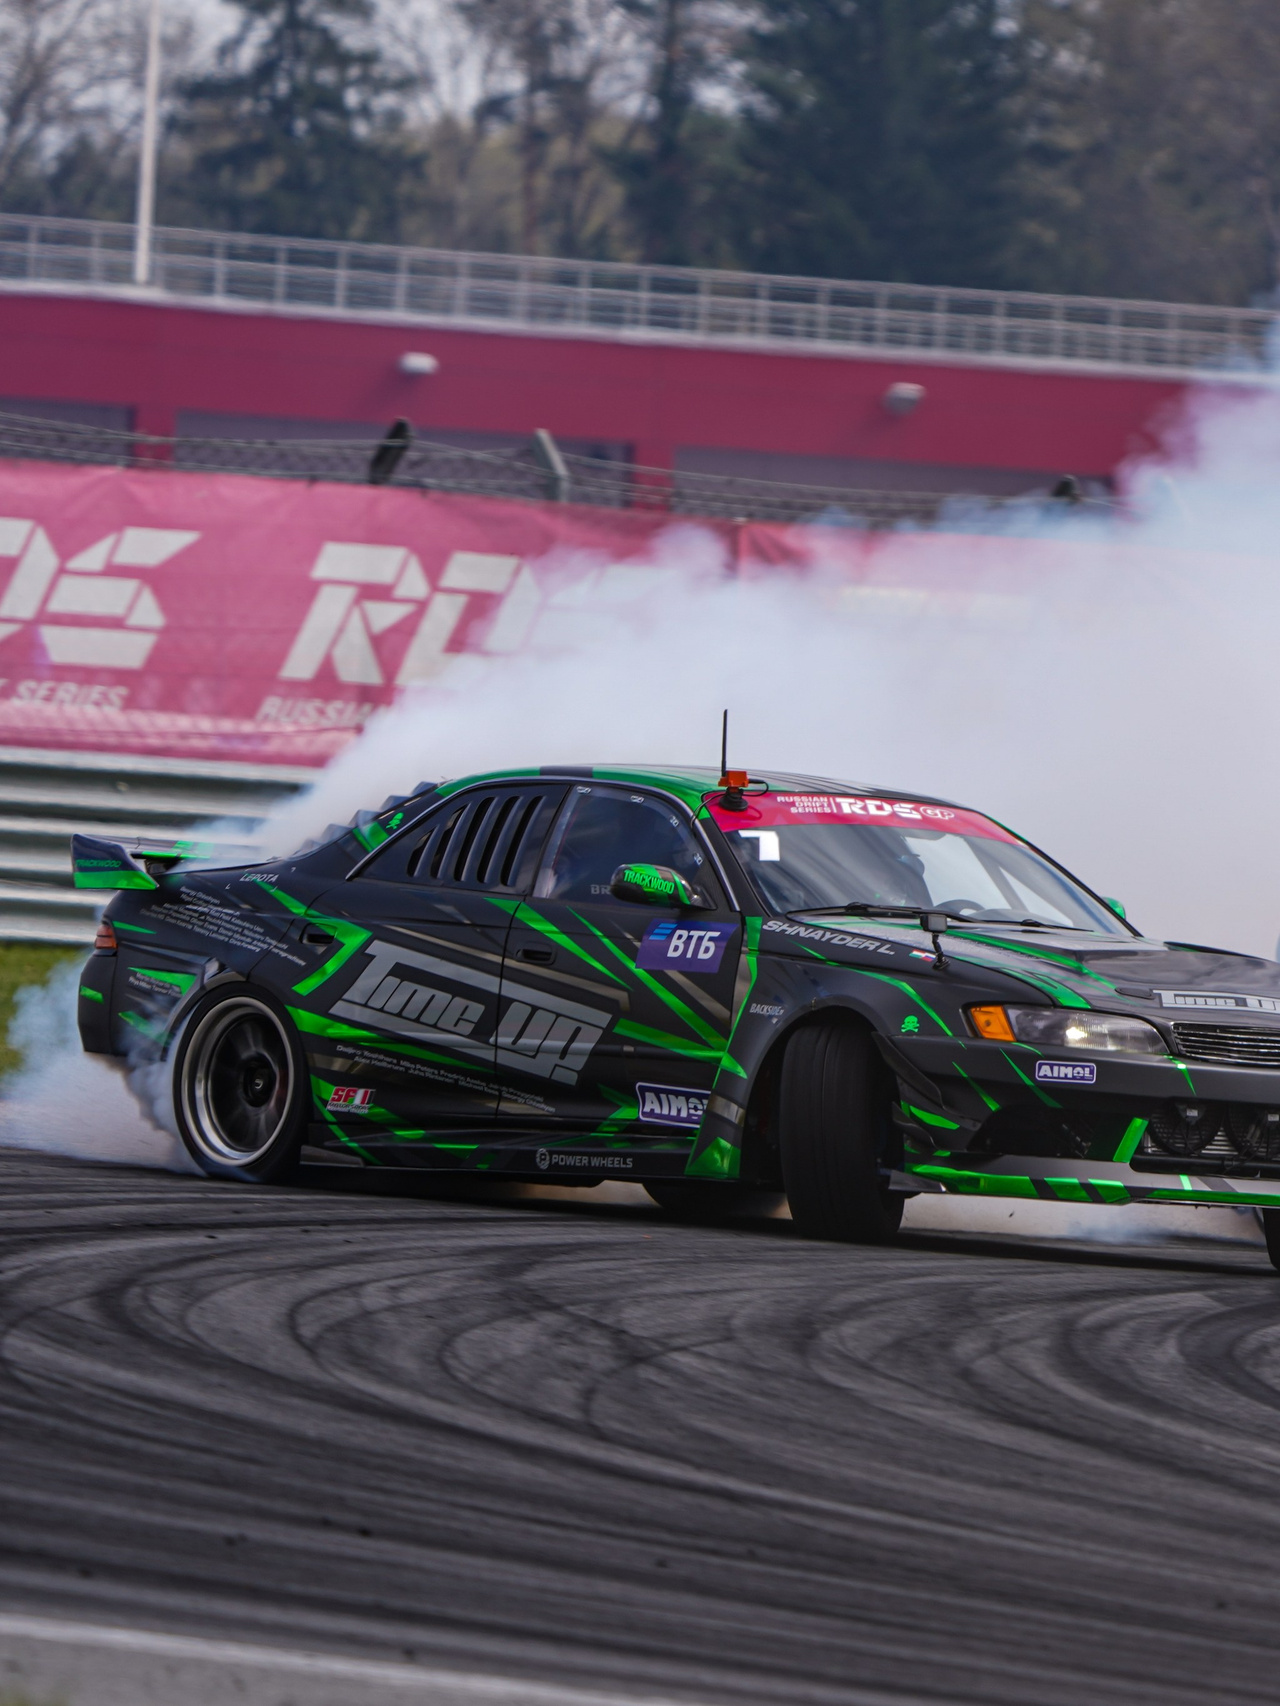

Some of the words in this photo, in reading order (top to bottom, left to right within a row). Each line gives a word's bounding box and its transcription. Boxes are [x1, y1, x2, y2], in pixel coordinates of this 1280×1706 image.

[277, 541, 550, 686] RD
[11, 679, 130, 711] SERIES
[255, 695, 390, 728] RUSSIA
[777, 796, 829, 804] RUSSIAN
[835, 797, 922, 820] RDS
[790, 806, 832, 814] SERIES
[920, 806, 955, 820] GP
[239, 873, 280, 883] LEPOTA
[623, 869, 675, 895] TRACKWOOD
[762, 920, 877, 952] SHNAYDER
[877, 944, 897, 956] L.
[749, 1003, 781, 1016] BACKSIDE
[1039, 1064, 1094, 1080] AIMOL
[643, 1091, 708, 1118] AIMO
[551, 1154, 589, 1167] POWER
[590, 1156, 634, 1168] WHEELS
